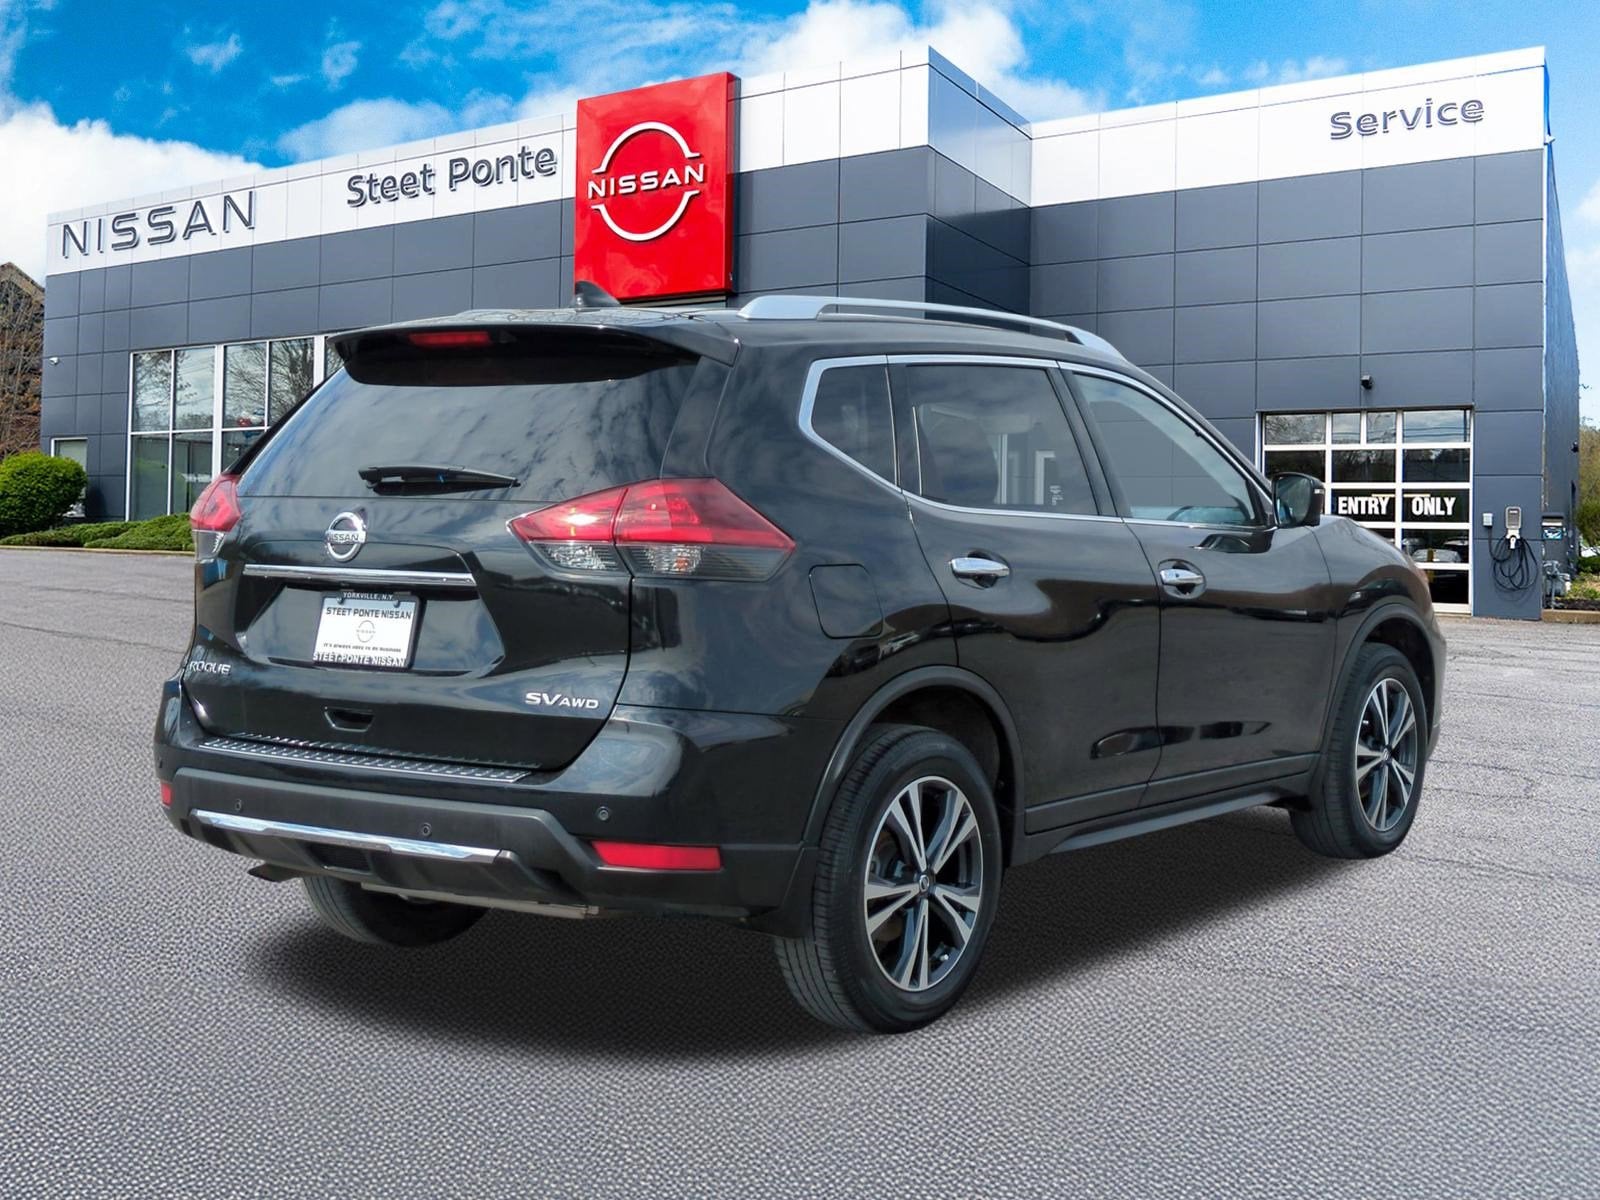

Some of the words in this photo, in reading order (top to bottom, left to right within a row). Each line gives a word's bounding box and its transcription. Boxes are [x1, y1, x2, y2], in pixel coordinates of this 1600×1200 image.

[1330, 97, 1485, 140] Service
[347, 163, 436, 207] Steet
[449, 146, 558, 192] Ponte
[587, 163, 705, 200] NISSAN
[62, 190, 256, 259] NISSAN
[1338, 496, 1390, 515] ENTRY
[1411, 496, 1456, 516] ONLY
[326, 607, 352, 616] STEET
[353, 608, 380, 618] PONTE
[381, 610, 412, 619] NISSAN
[189, 660, 231, 675] ROGUE
[312, 652, 338, 662] STEET
[339, 653, 370, 664] PONTE
[371, 655, 405, 667] NISSAN
